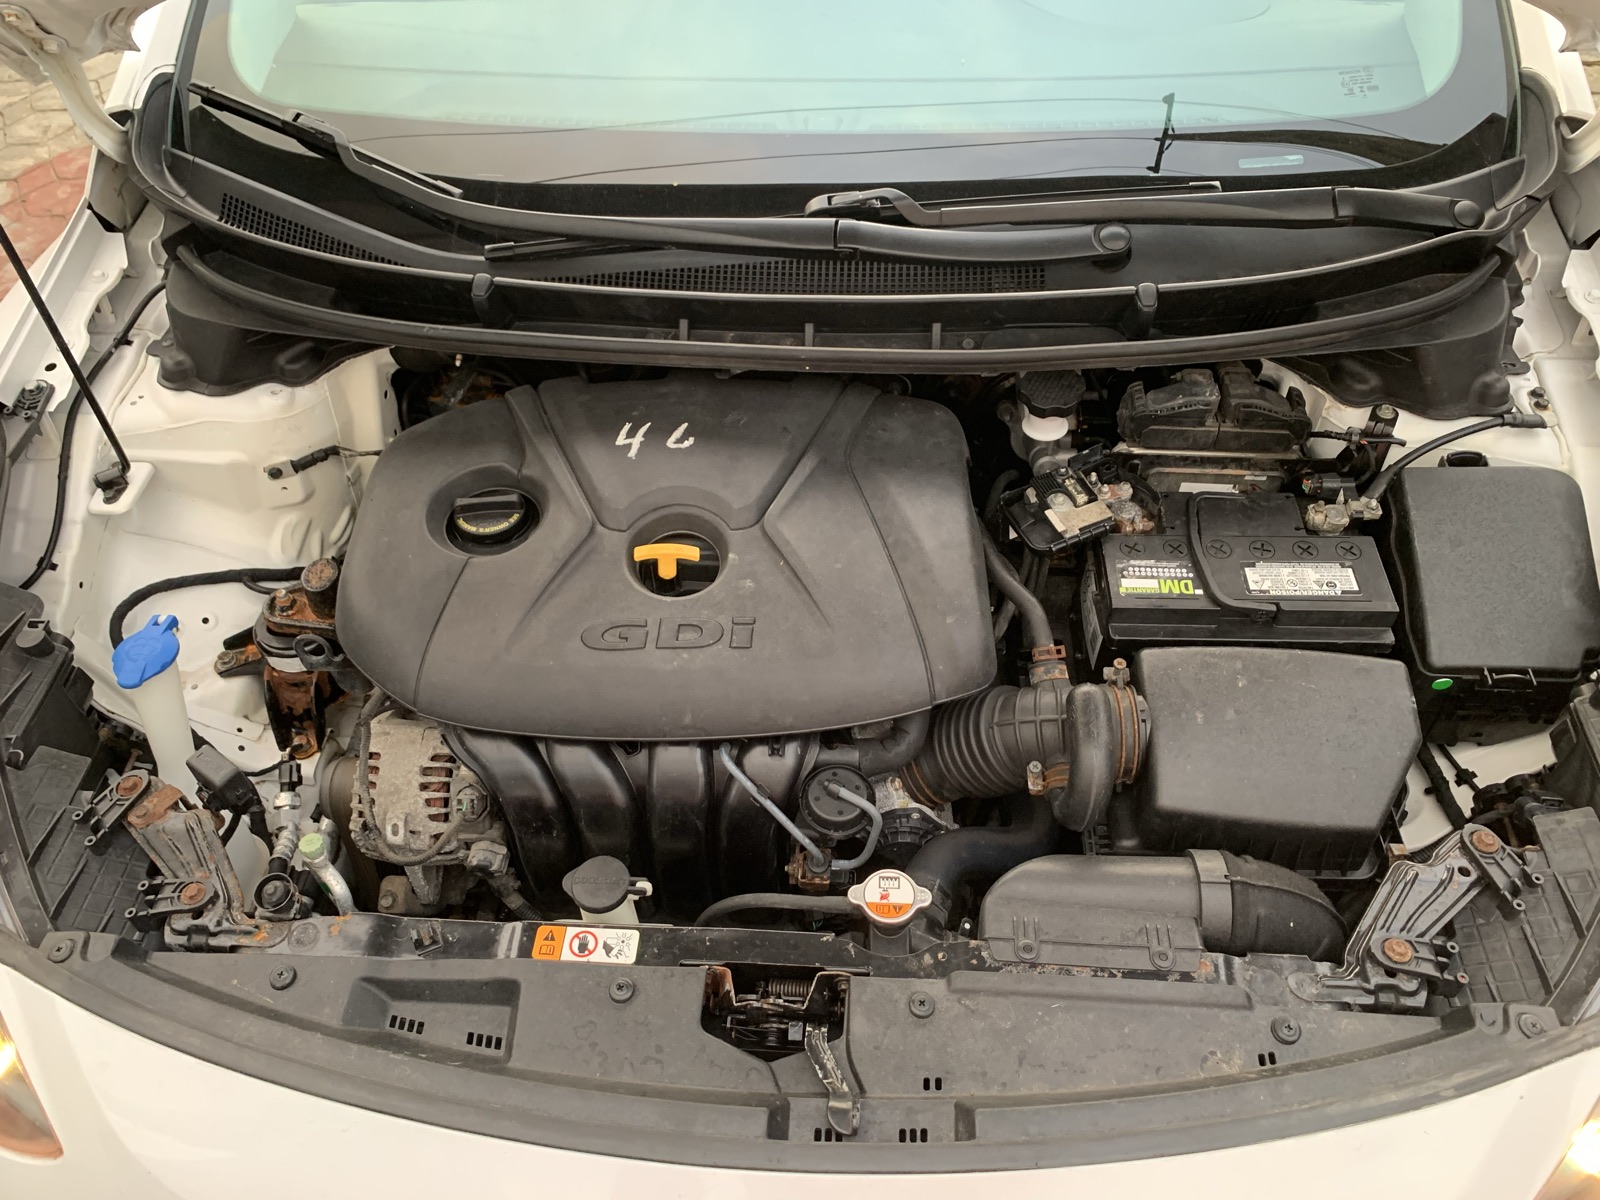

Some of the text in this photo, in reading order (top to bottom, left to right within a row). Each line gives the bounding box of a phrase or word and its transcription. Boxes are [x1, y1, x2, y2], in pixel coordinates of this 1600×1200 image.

[457, 513, 520, 533] SEE OWNER'S MANUAL
[1159, 579, 1195, 595] DM
[574, 876, 627, 888] COOLANT
